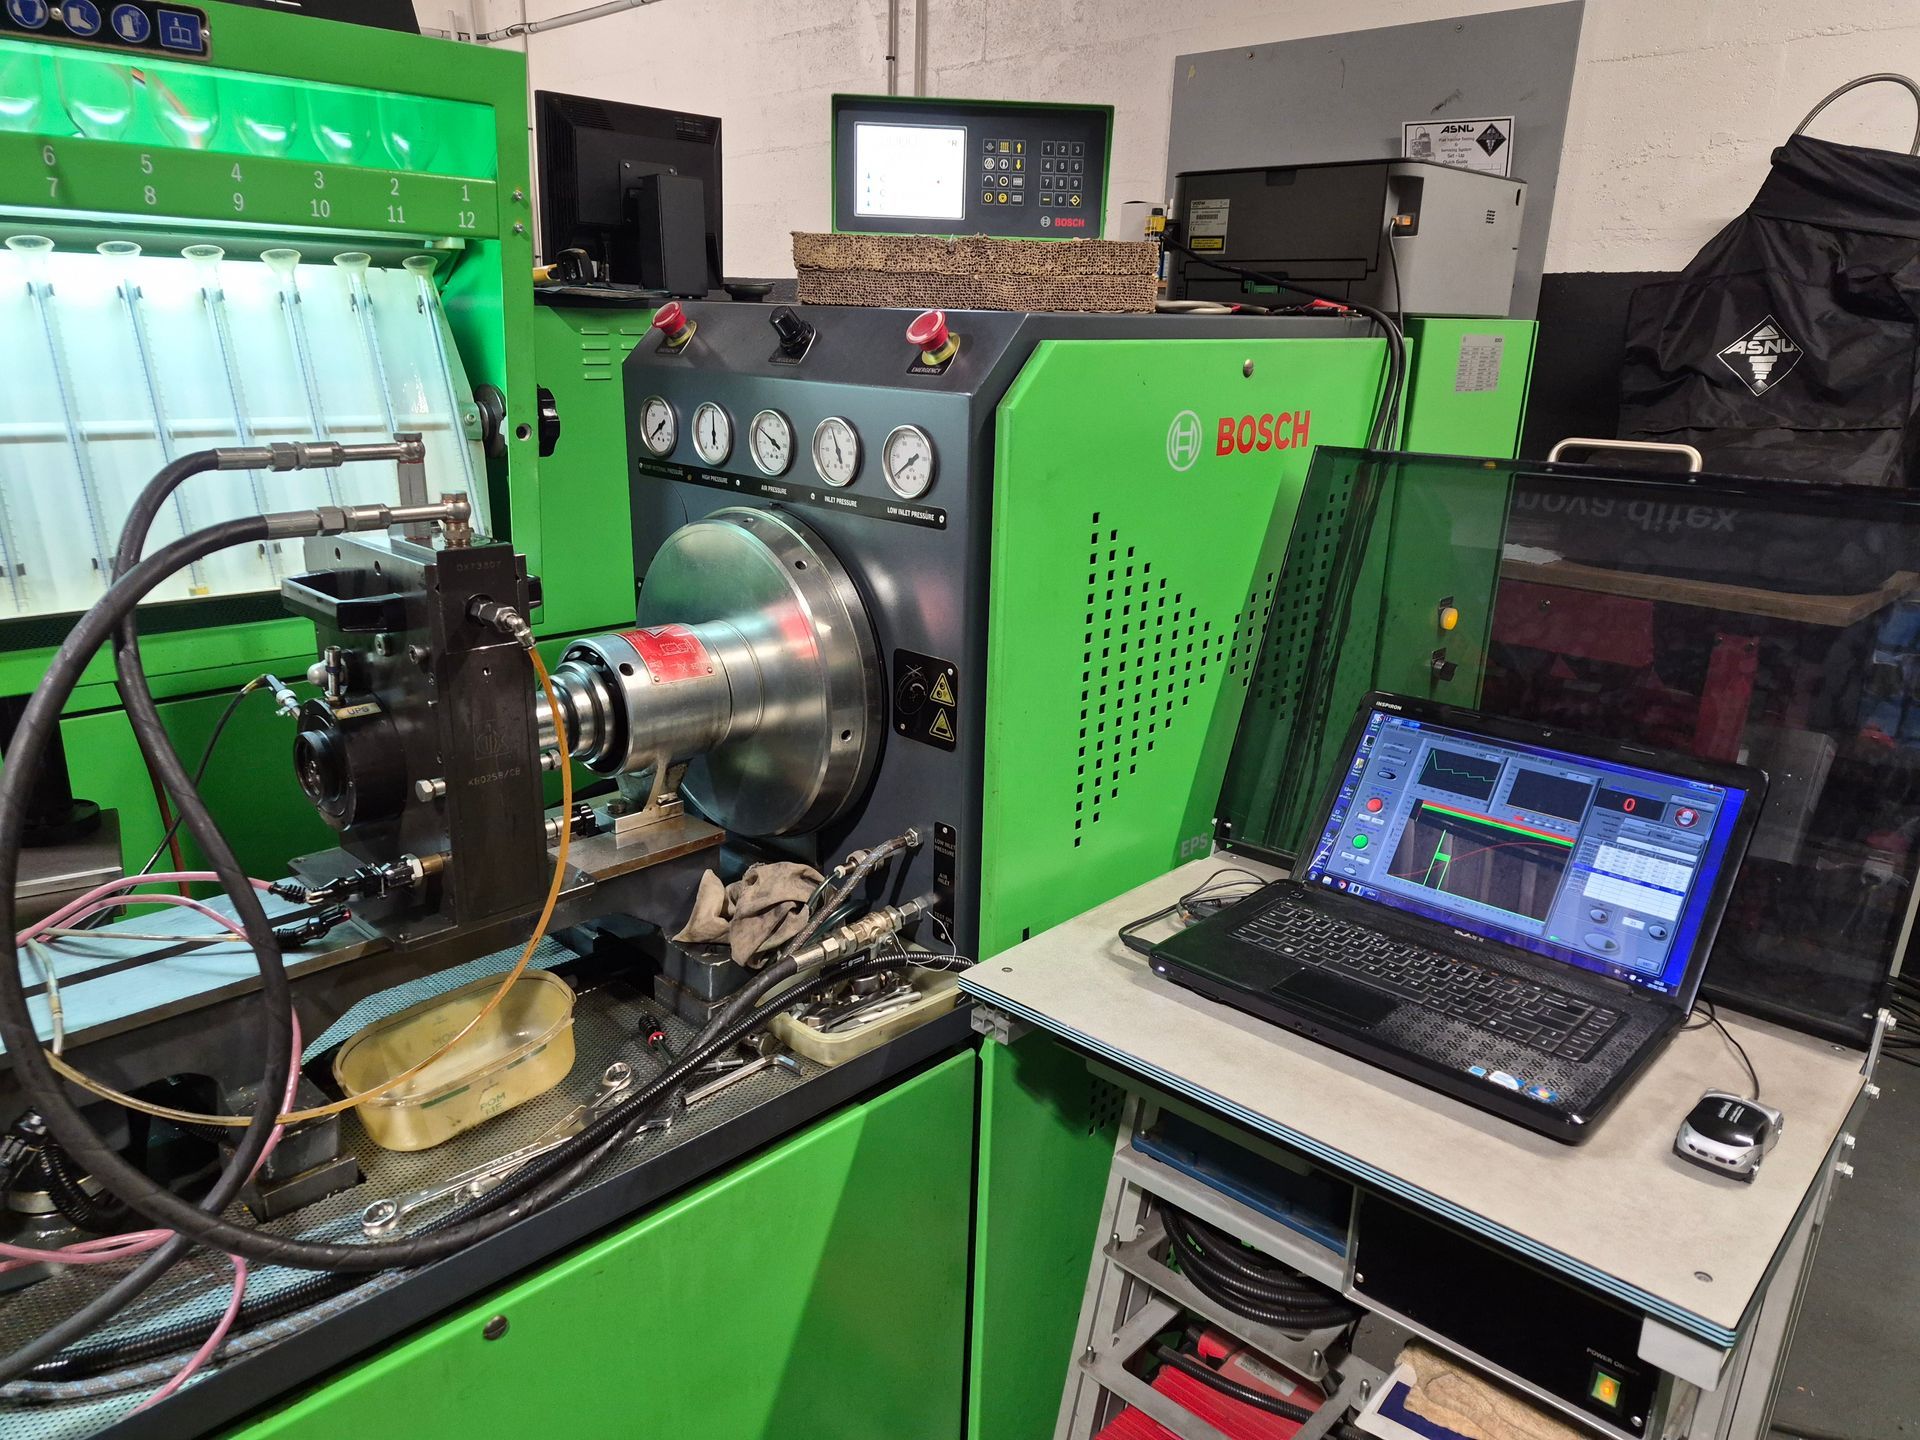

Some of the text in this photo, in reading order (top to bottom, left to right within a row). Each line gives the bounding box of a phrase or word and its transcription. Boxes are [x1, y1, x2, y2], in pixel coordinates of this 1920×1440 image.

[1441, 125, 1474, 134] ASNU
[43, 145, 470, 202] 6 5 4 3 2 1
[46, 177, 476, 229] 7 8 9 10 11 12
[1054, 217, 1086, 227] BOSCH
[1216, 410, 1311, 456] BOSCH
[710, 475, 728, 484] PRESSURE
[767, 486, 788, 495] PRESSURE
[824, 495, 858, 508] INLET PRESSURE
[887, 506, 935, 521] LOW INLET PRESSURE
[1375, 701, 1403, 711] INSPIRON
[1623, 797, 1637, 814] 0
[934, 845, 955, 858] PRESSURE
[1181, 832, 1209, 859] EPS
[937, 877, 950, 887] INLET
[939, 872, 948, 880] AIR
[480, 1091, 506, 1112] POM
[1586, 1346, 1613, 1364] POWER
